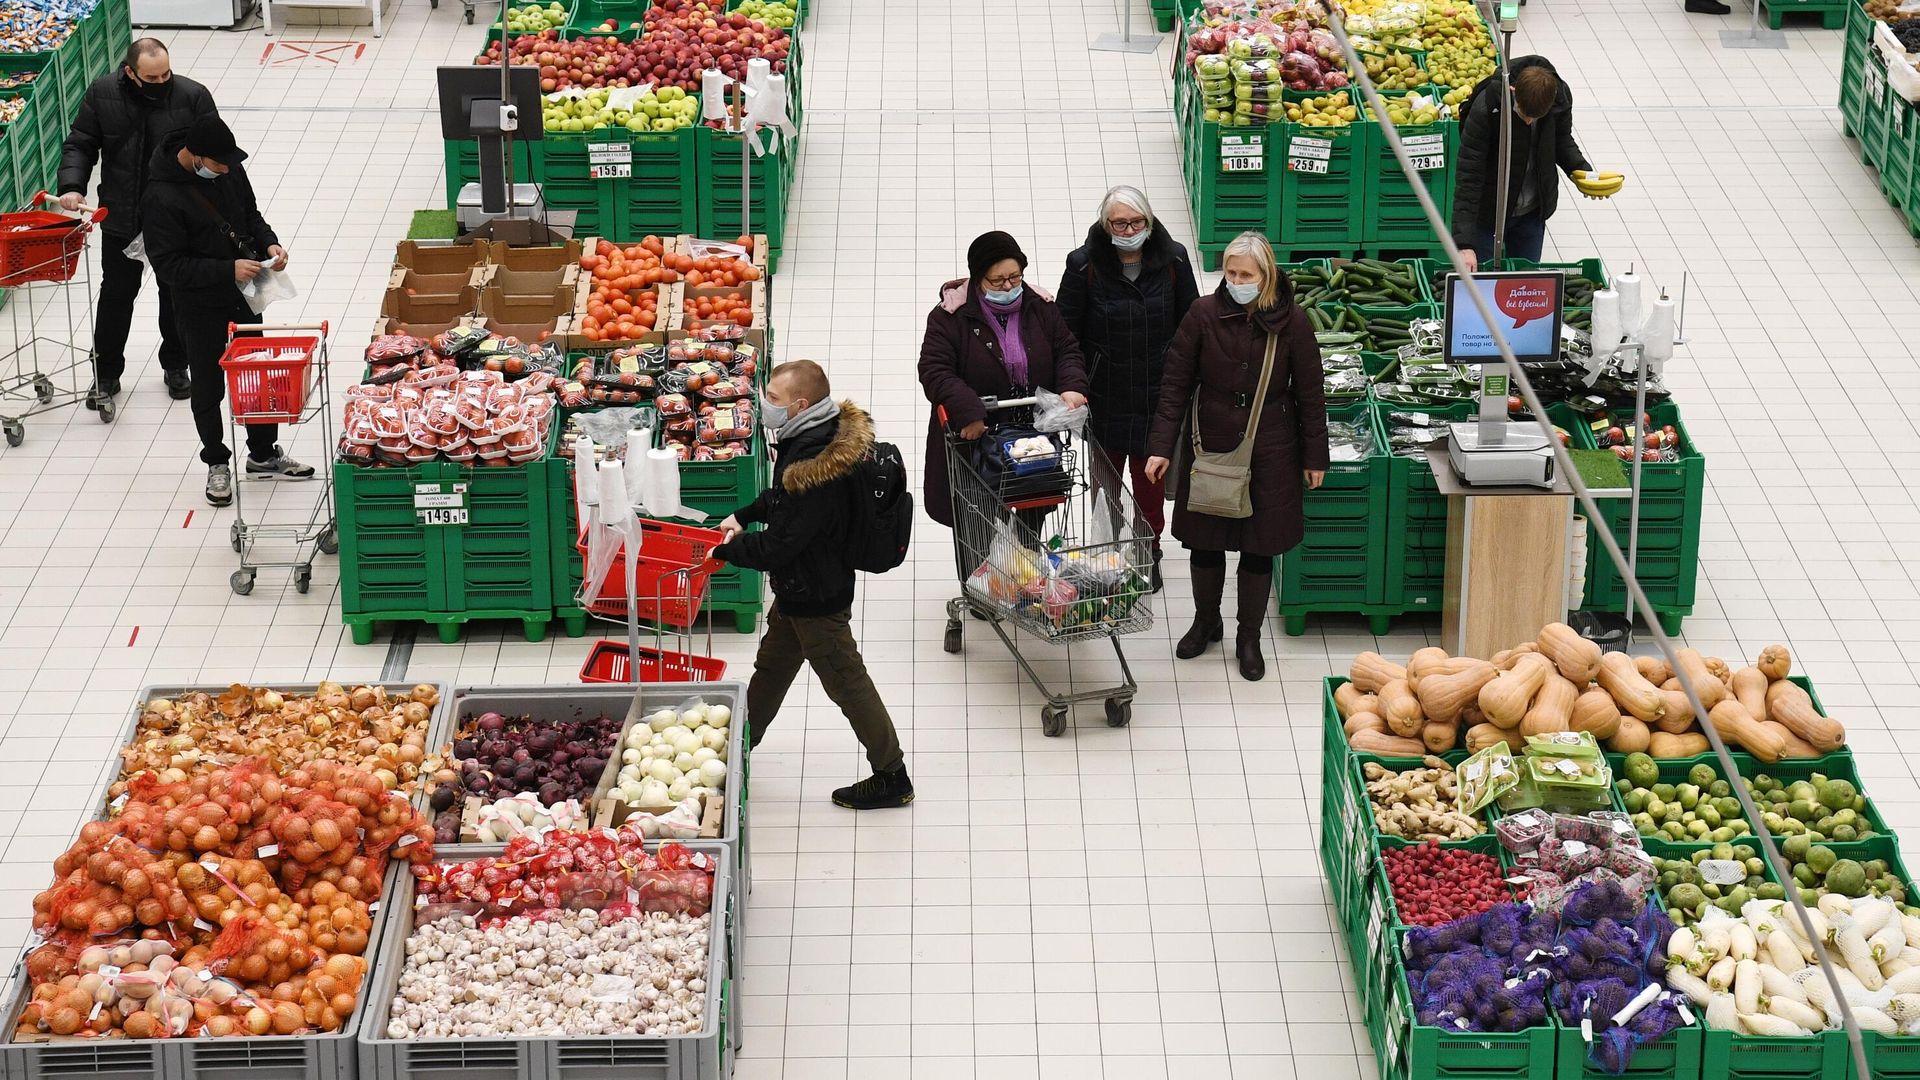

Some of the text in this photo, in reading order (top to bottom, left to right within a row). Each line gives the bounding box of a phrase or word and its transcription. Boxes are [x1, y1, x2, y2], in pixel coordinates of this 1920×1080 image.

[1231, 158, 1248, 169] 109
[1295, 159, 1314, 170] 259
[599, 166, 617, 176] 159
[1510, 287, 1546, 298] Давайте
[427, 509, 450, 523] 149
